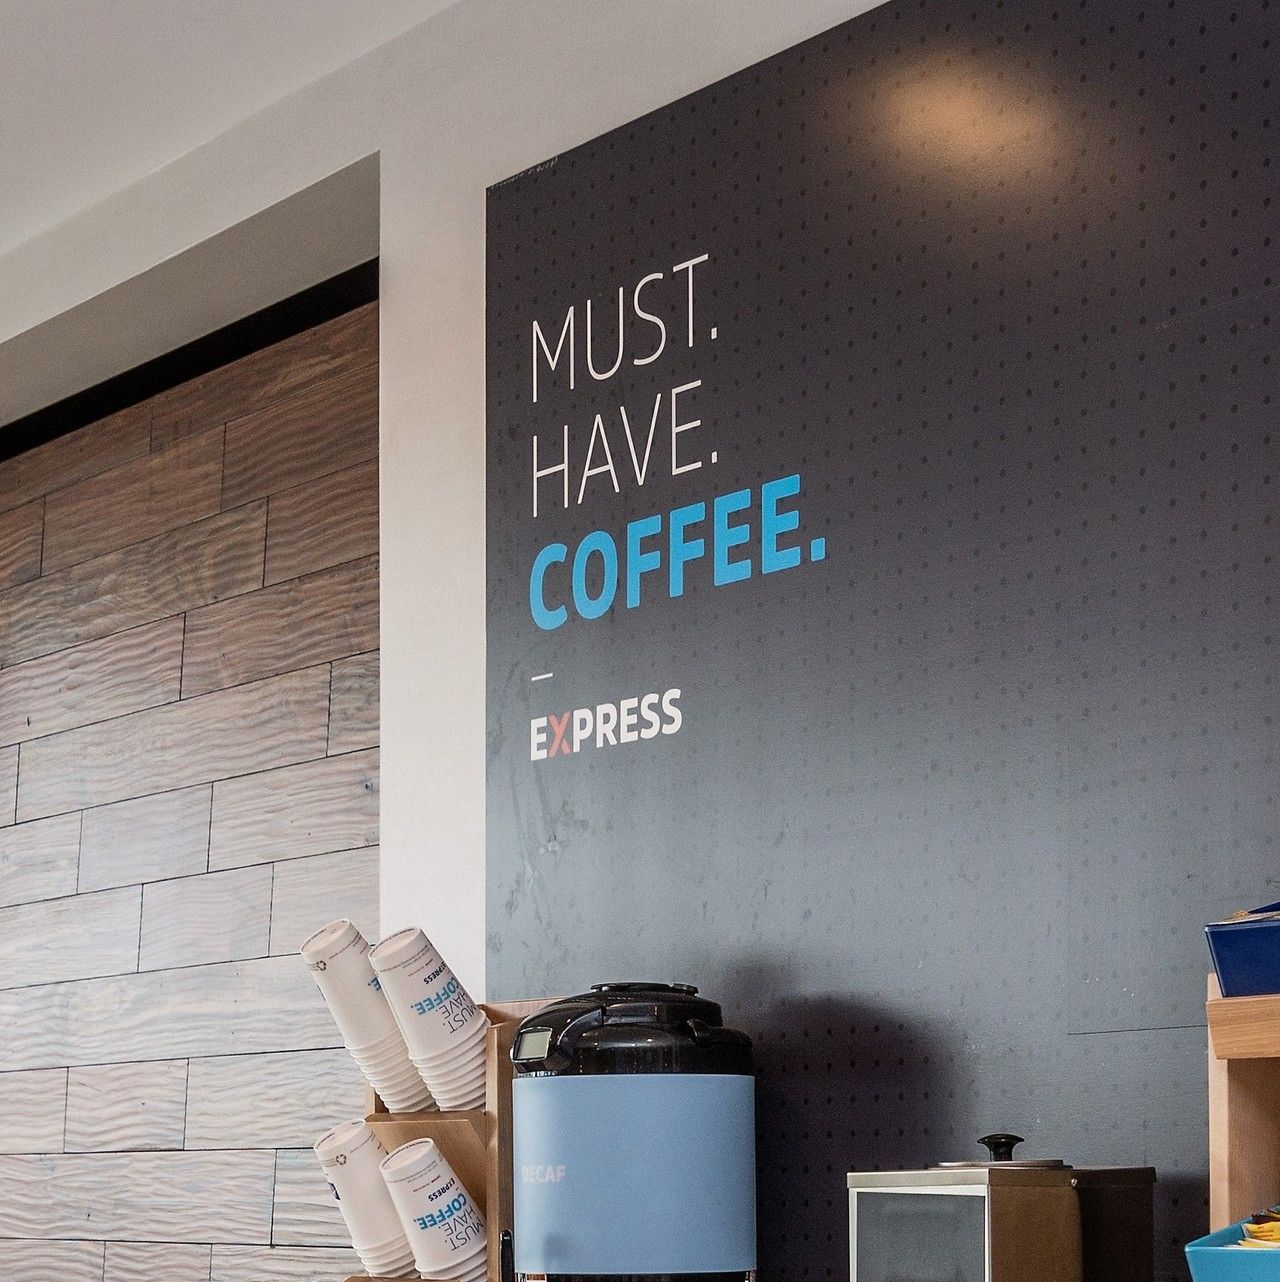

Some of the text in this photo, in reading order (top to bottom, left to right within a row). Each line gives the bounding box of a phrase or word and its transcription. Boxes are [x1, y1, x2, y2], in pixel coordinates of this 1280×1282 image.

[532, 253, 718, 403] MUST.
[532, 379, 718, 518] HAVE.
[529, 474, 826, 630] COFFEE.
[531, 688, 683, 761] EXPRESS
[410, 976, 460, 1016] COFFEE.
[435, 989, 468, 1019] HAVE.
[443, 1004, 477, 1034] MUST.
[523, 1165, 566, 1183] DECAF
[414, 1193, 467, 1230] COFFEE.
[438, 1206, 476, 1237] HAVE.
[445, 1216, 485, 1251] MUST.
